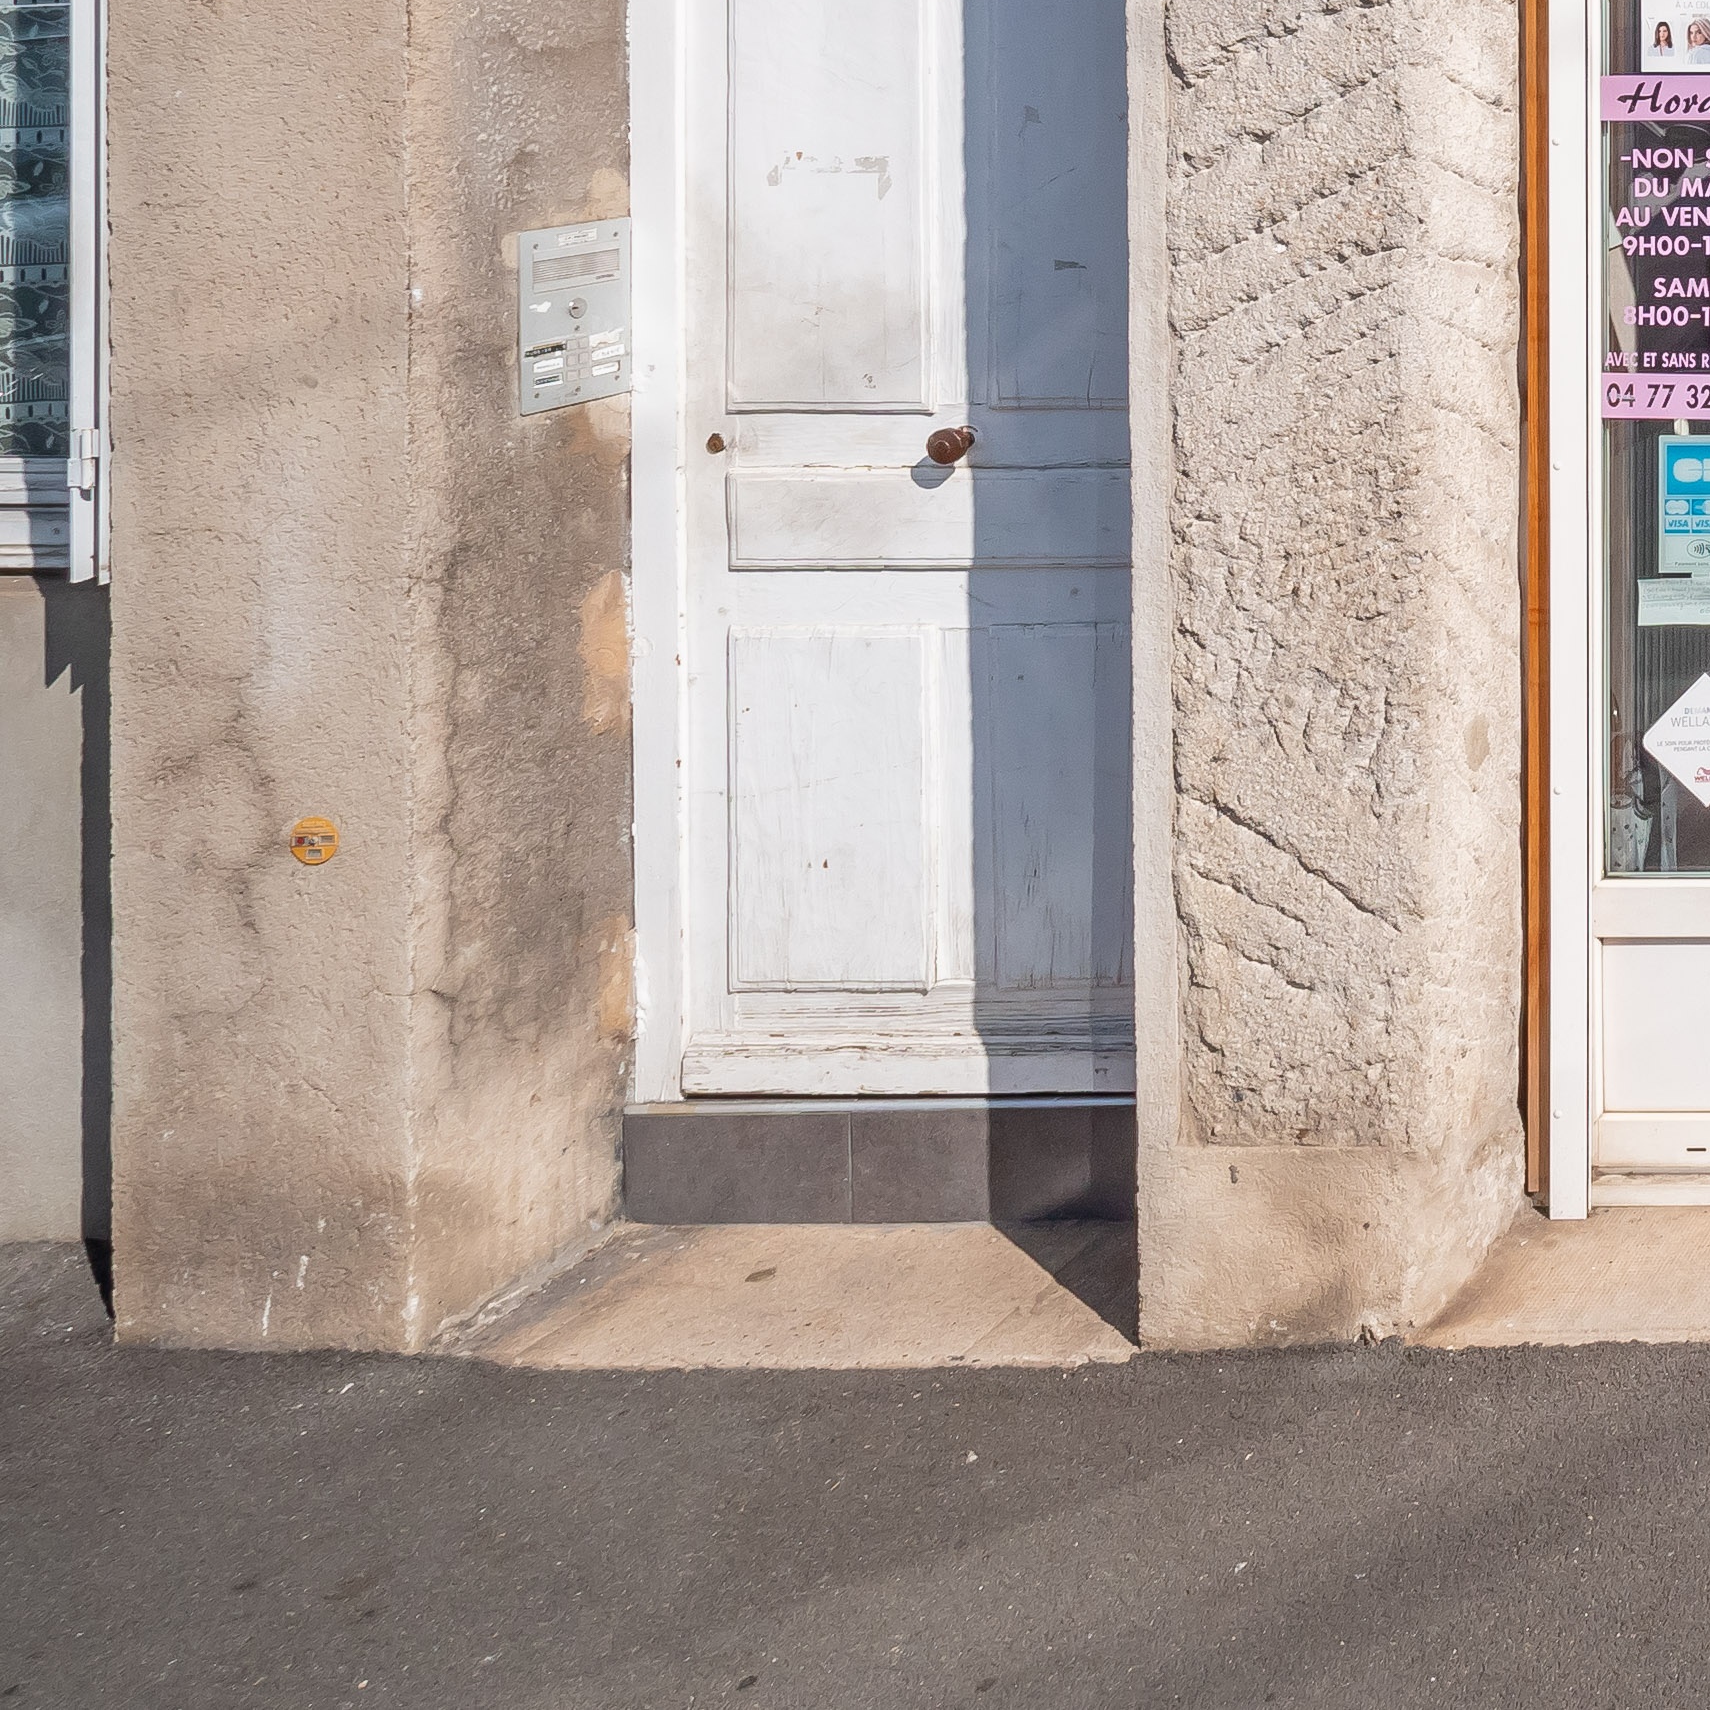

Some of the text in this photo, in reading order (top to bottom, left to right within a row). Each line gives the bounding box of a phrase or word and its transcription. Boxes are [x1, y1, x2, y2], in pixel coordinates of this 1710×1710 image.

[1634, 178, 1669, 198] DU
[1615, 206, 1650, 226] AU
[1604, 352, 1638, 367] AVEC
[1643, 352, 1657, 367] ET
[1662, 353, 1696, 368] SANS
[1647, 384, 1676, 408] 77
